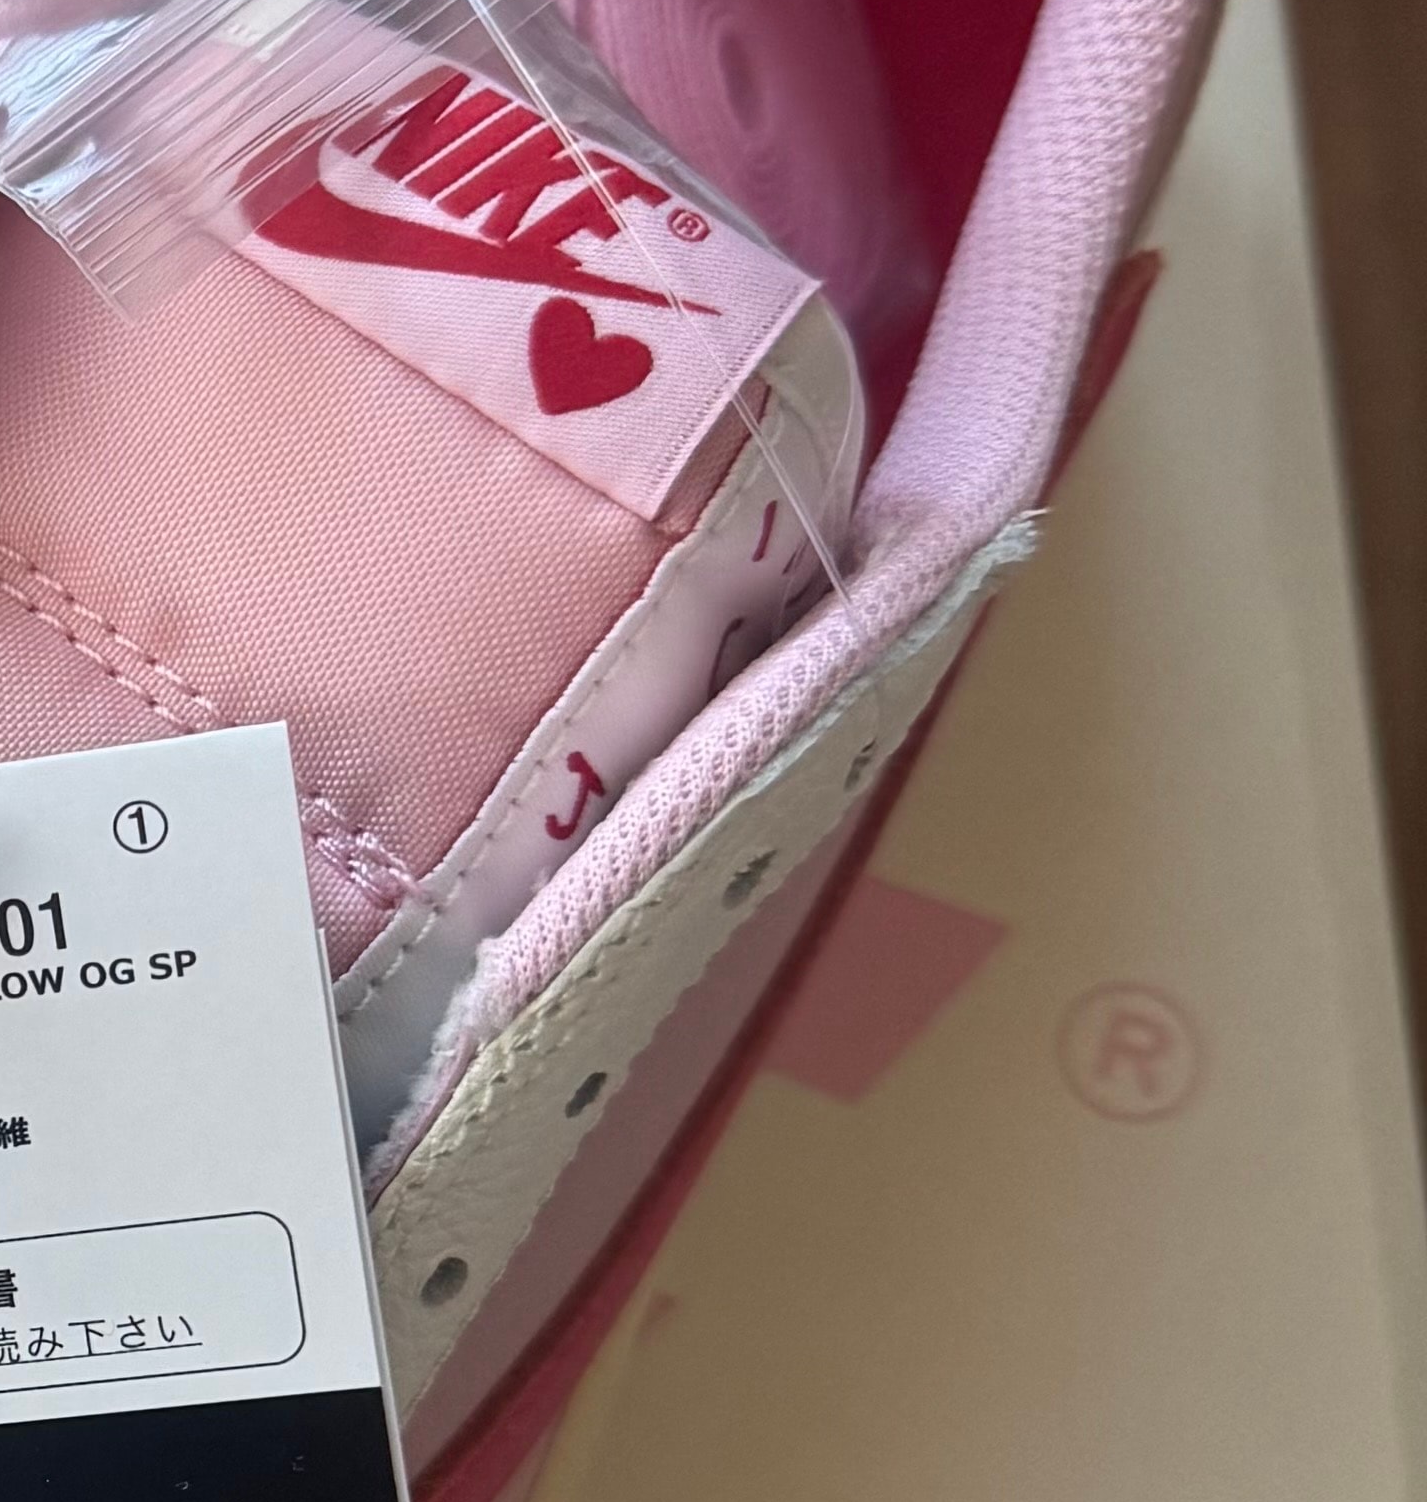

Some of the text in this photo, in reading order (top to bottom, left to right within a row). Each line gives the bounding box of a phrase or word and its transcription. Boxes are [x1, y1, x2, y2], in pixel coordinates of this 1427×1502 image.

[331, 64, 672, 268] NIKE
[79, 957, 136, 990] OG
[148, 950, 198, 982] SP
